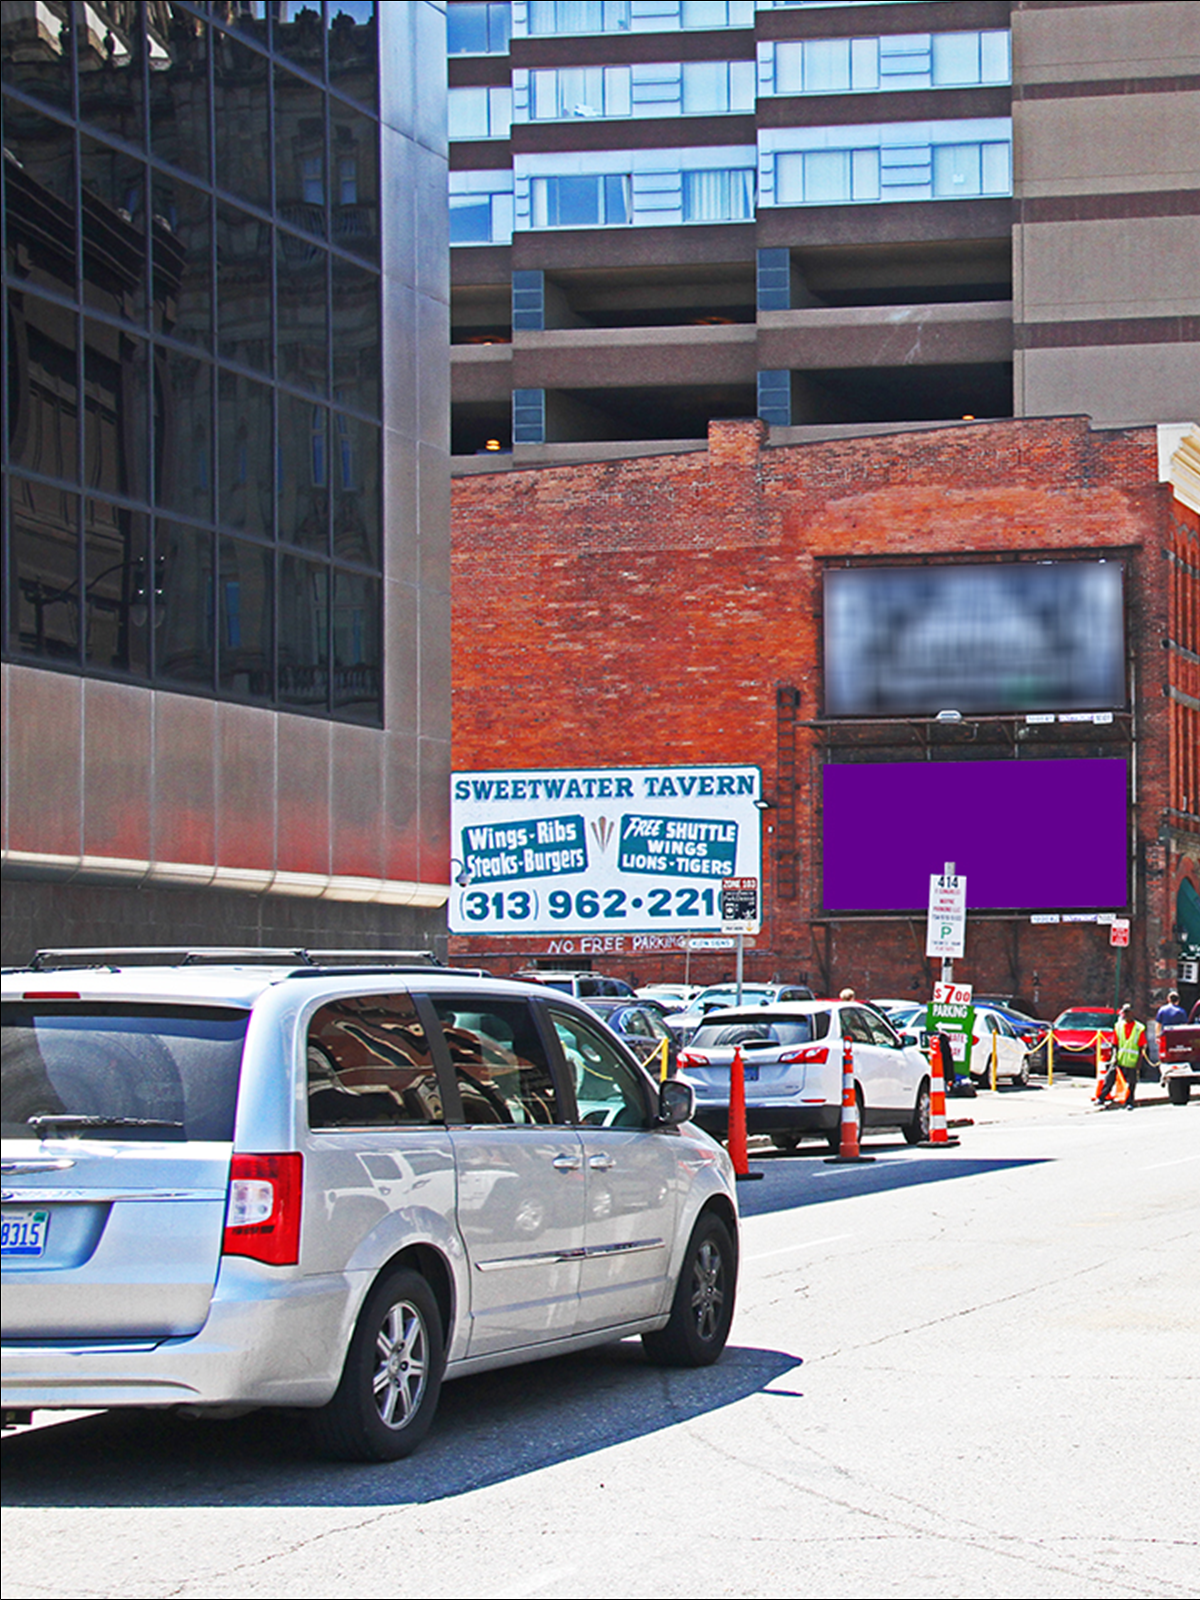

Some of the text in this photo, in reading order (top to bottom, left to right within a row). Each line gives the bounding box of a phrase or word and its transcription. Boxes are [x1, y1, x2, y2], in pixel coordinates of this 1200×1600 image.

[455, 775, 755, 800] SWEETWATER TAVERN
[623, 817, 736, 842] FREE SHUTTLE
[647, 839, 708, 857] WINGS
[937, 876, 959, 888] 414
[460, 889, 539, 921] (313)
[941, 926, 952, 939] P
[547, 939, 574, 954] NO
[581, 937, 625, 953] FREE
[633, 935, 686, 950] PARKING
[932, 1004, 968, 1018] PARKING
[1, 1223, 41, 1246] 8315
